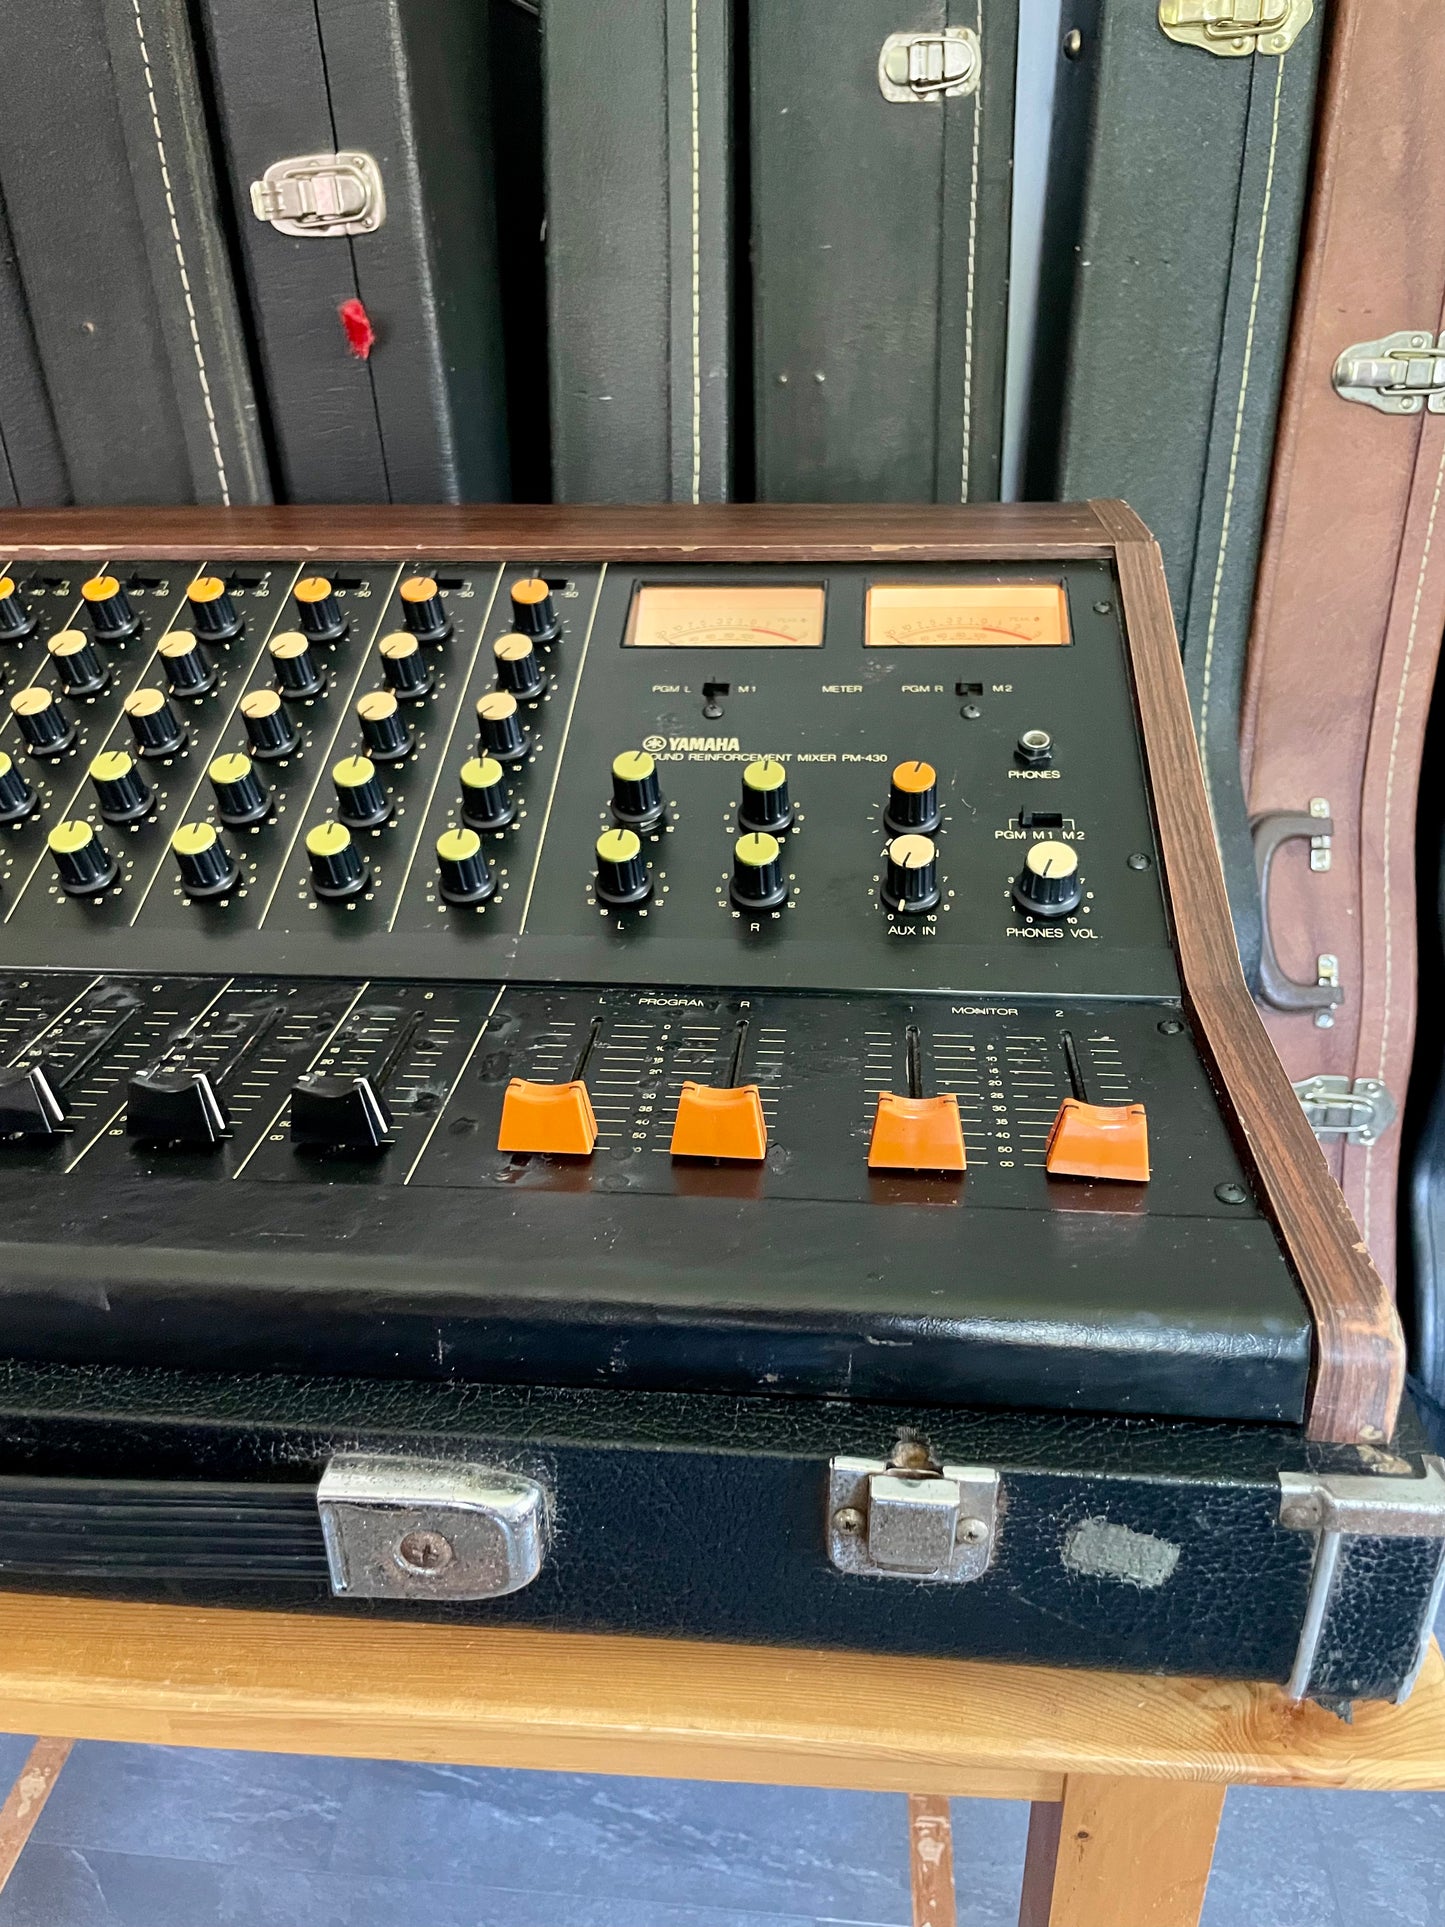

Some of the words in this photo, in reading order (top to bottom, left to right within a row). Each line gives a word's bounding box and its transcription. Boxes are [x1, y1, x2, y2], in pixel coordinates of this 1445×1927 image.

[822, 685, 862, 693] METER
[669, 737, 739, 751] YAMAHA
[649, 752, 684, 761] OUND
[688, 752, 792, 762] REINFORCEMENT
[842, 754, 887, 762] PM-430
[1008, 770, 1060, 779] PHONES
[995, 831, 1026, 839] PGM
[617, 921, 624, 929] L
[751, 923, 759, 931] R
[888, 926, 916, 935] AUX
[923, 927, 935, 935] IN
[1007, 928, 1063, 938] PHONES
[1070, 929, 1098, 938] VOL
[952, 1007, 1018, 1015] MONITOR
